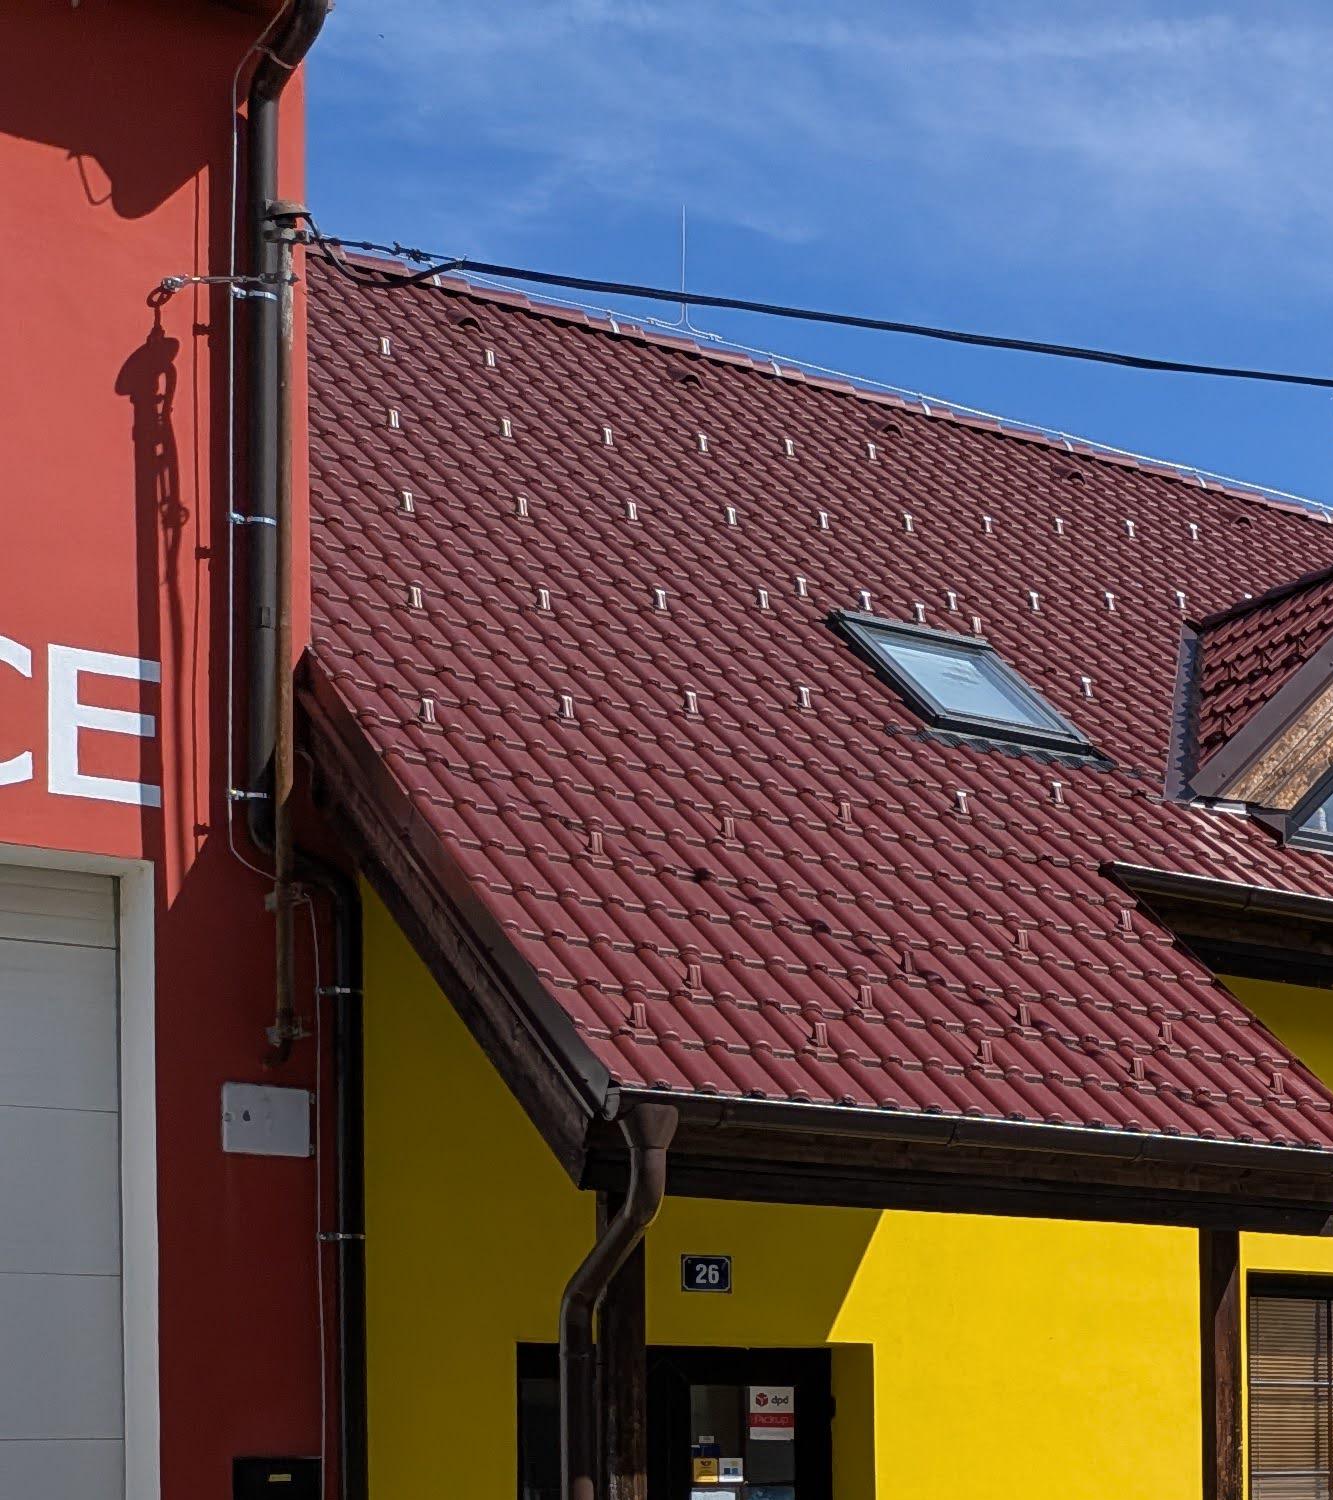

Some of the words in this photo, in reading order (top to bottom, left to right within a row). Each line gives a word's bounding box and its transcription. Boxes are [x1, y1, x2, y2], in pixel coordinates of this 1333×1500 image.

[0, 635, 161, 808] E
[695, 1263, 720, 1284] 26
[771, 1395, 789, 1406] dpd
